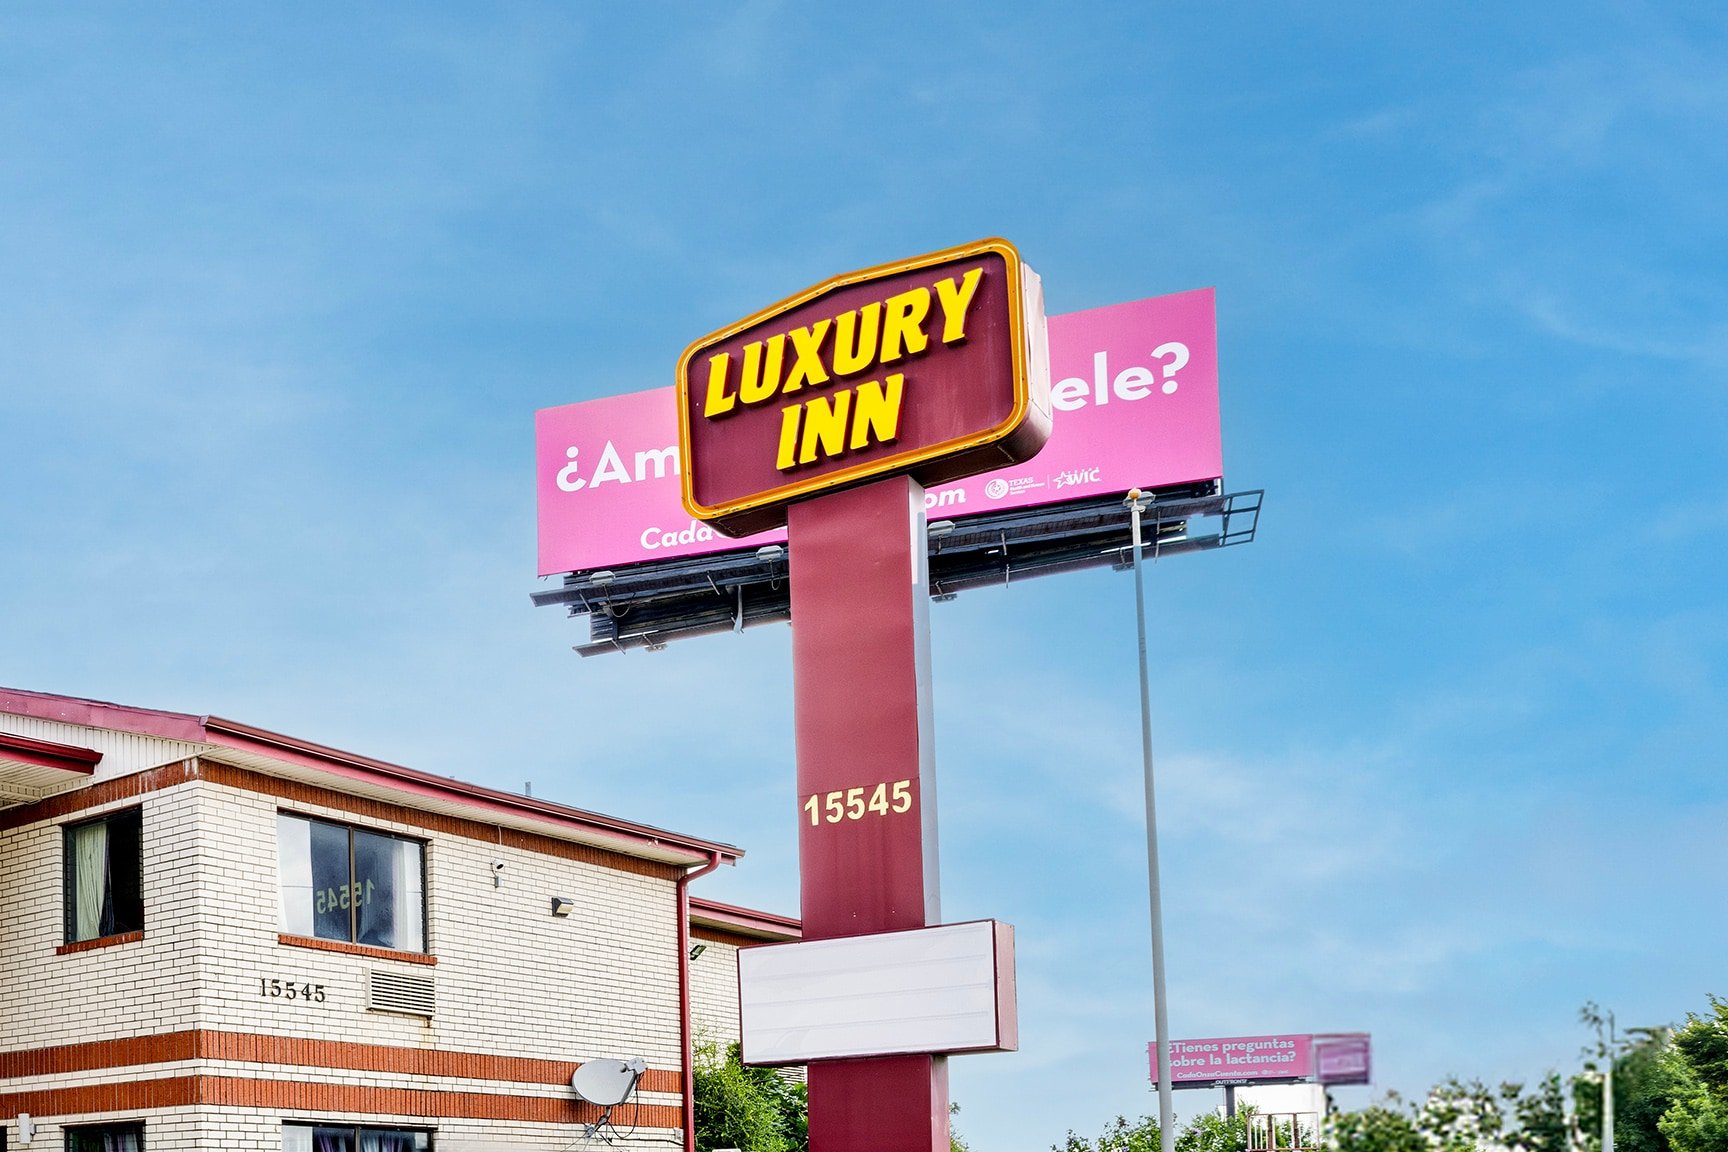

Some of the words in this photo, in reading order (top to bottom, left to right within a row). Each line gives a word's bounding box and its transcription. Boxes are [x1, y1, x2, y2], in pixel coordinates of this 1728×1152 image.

[704, 267, 984, 418] LUXURY
[776, 373, 905, 471] INN
[804, 779, 912, 826] 15545
[260, 978, 325, 1003] 15545
[1209, 1053, 1222, 1065] la
[1226, 1051, 1296, 1065] lactancia?
[1222, 1038, 1295, 1053] preguntas
